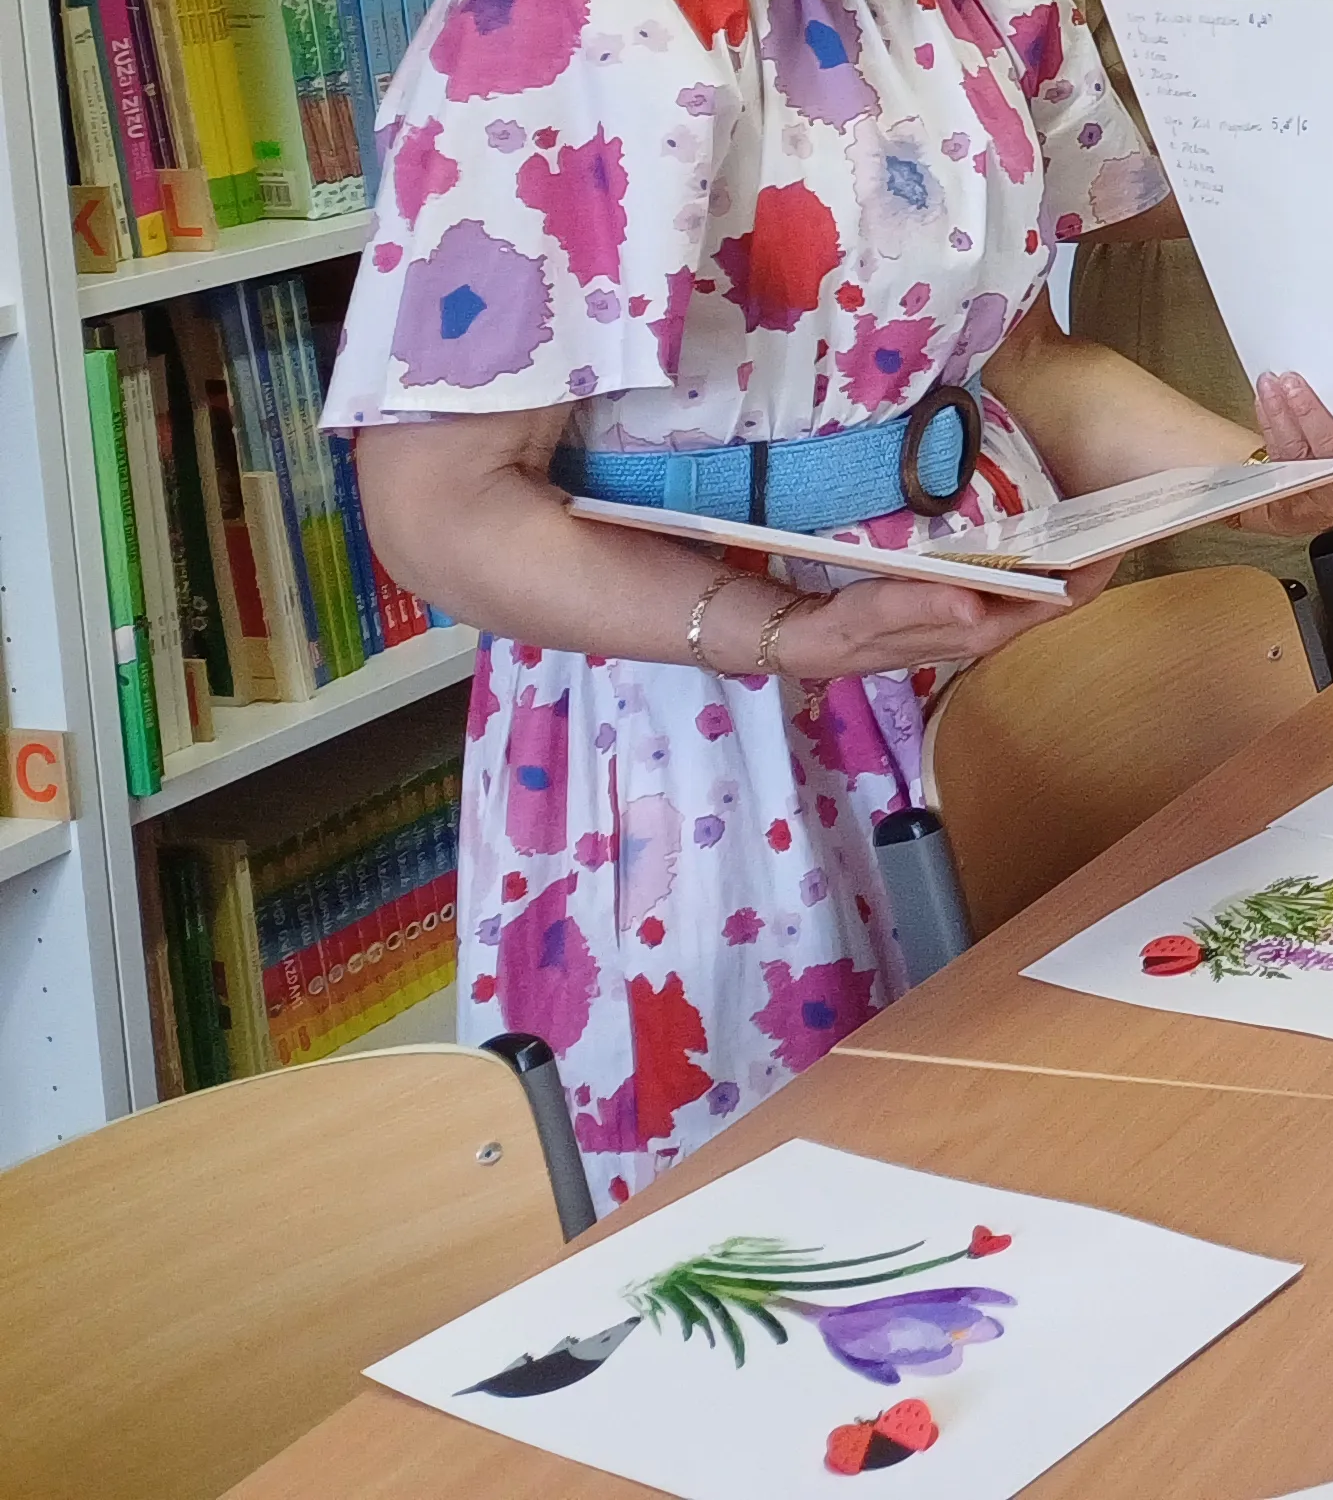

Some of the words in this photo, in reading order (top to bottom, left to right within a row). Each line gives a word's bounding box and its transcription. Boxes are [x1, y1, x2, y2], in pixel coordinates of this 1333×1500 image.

[121, 96, 146, 140] ZIZU
[162, 184, 203, 237] L
[15, 740, 59, 805] C
